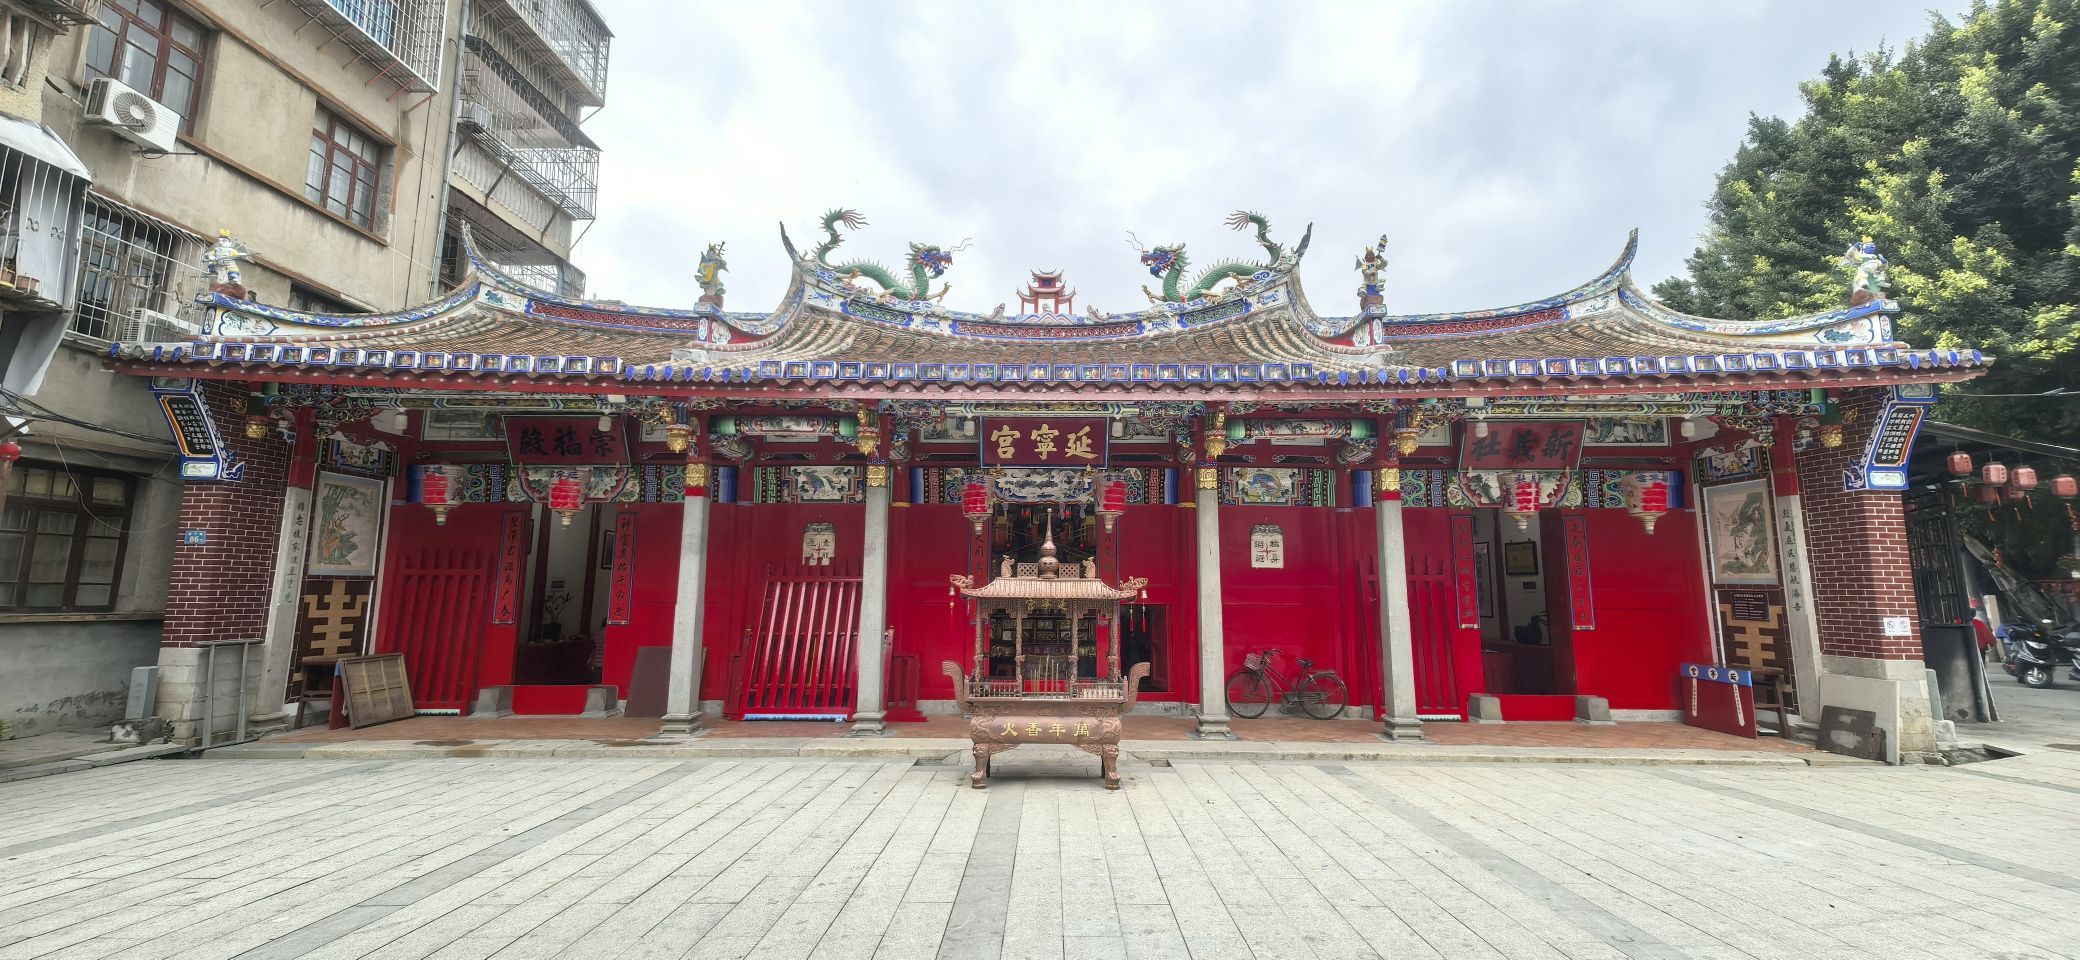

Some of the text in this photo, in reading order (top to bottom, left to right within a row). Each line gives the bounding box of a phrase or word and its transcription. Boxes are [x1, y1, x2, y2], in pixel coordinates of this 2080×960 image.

[519, 425, 616, 457] 崇福殿
[990, 424, 1098, 460] 延寧宮
[1000, 721, 1091, 737] 萬年香火
